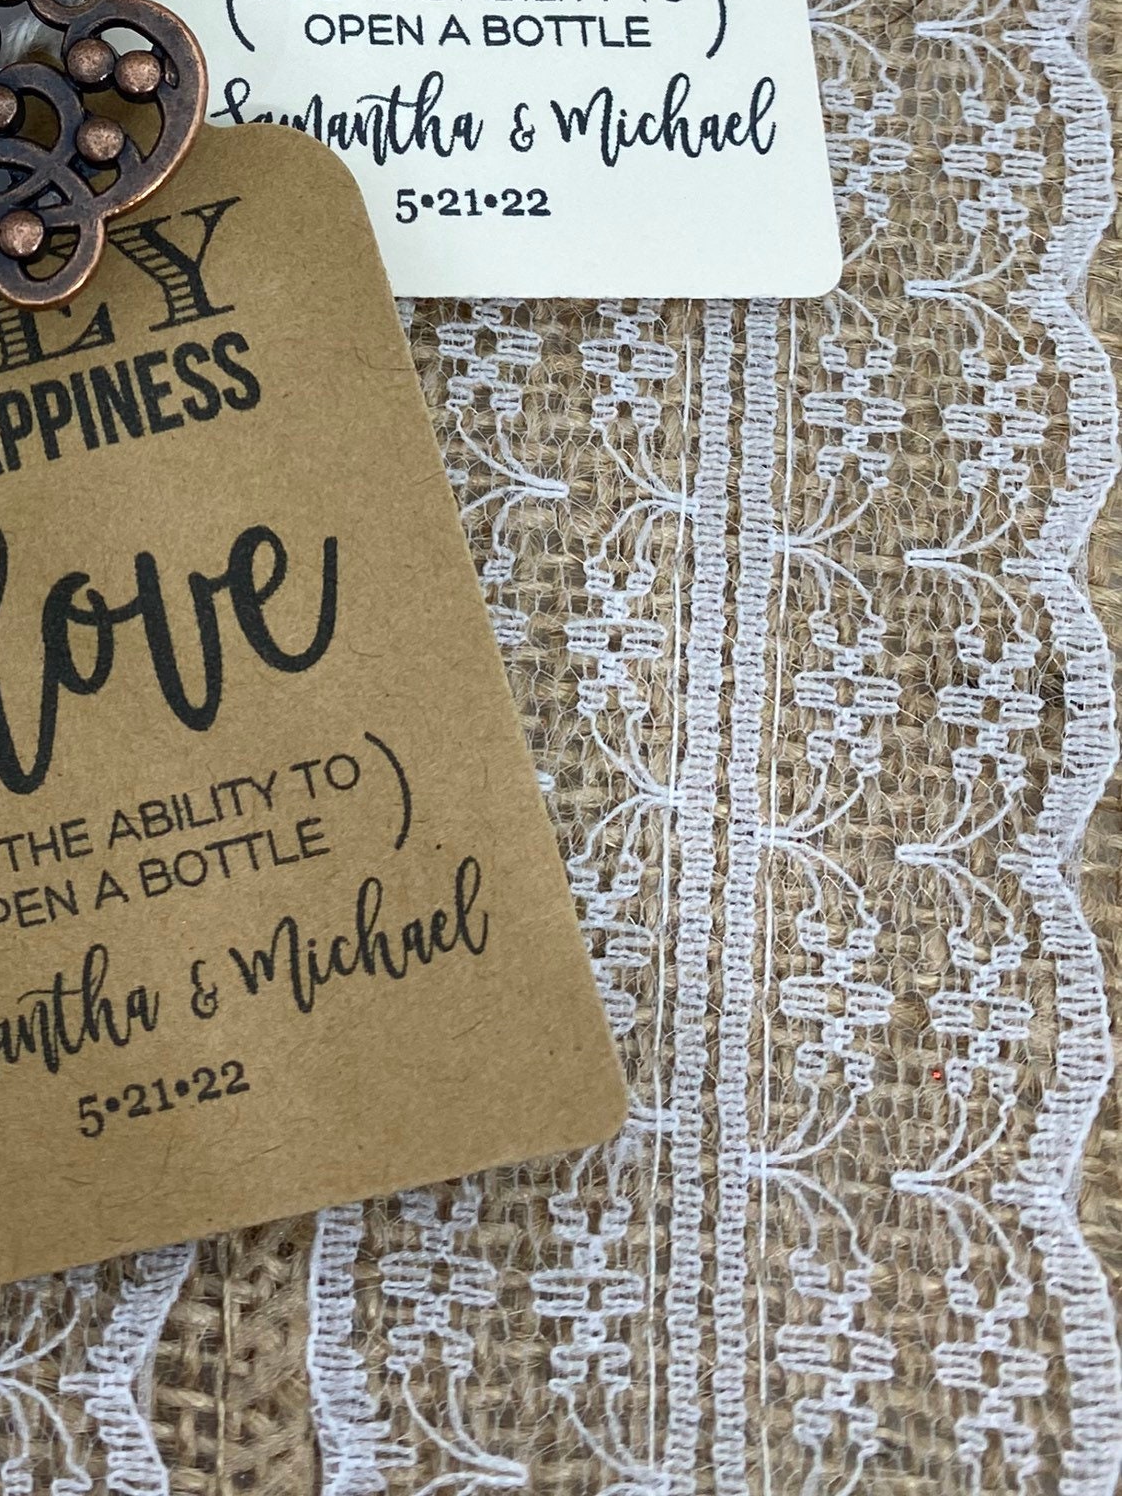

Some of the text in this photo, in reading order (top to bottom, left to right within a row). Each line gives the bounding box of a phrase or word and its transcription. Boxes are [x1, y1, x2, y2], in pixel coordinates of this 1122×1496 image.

[303, 13, 653, 49] OPEN A BOTTLE
[508, 101, 537, 154] &
[548, 71, 778, 169] Michael
[107, 770, 280, 849] ABILITY
[94, 869, 131, 911] A
[140, 816, 331, 898] BOTTLE
[189, 959, 221, 1020] &
[227, 855, 490, 1014] Michael
